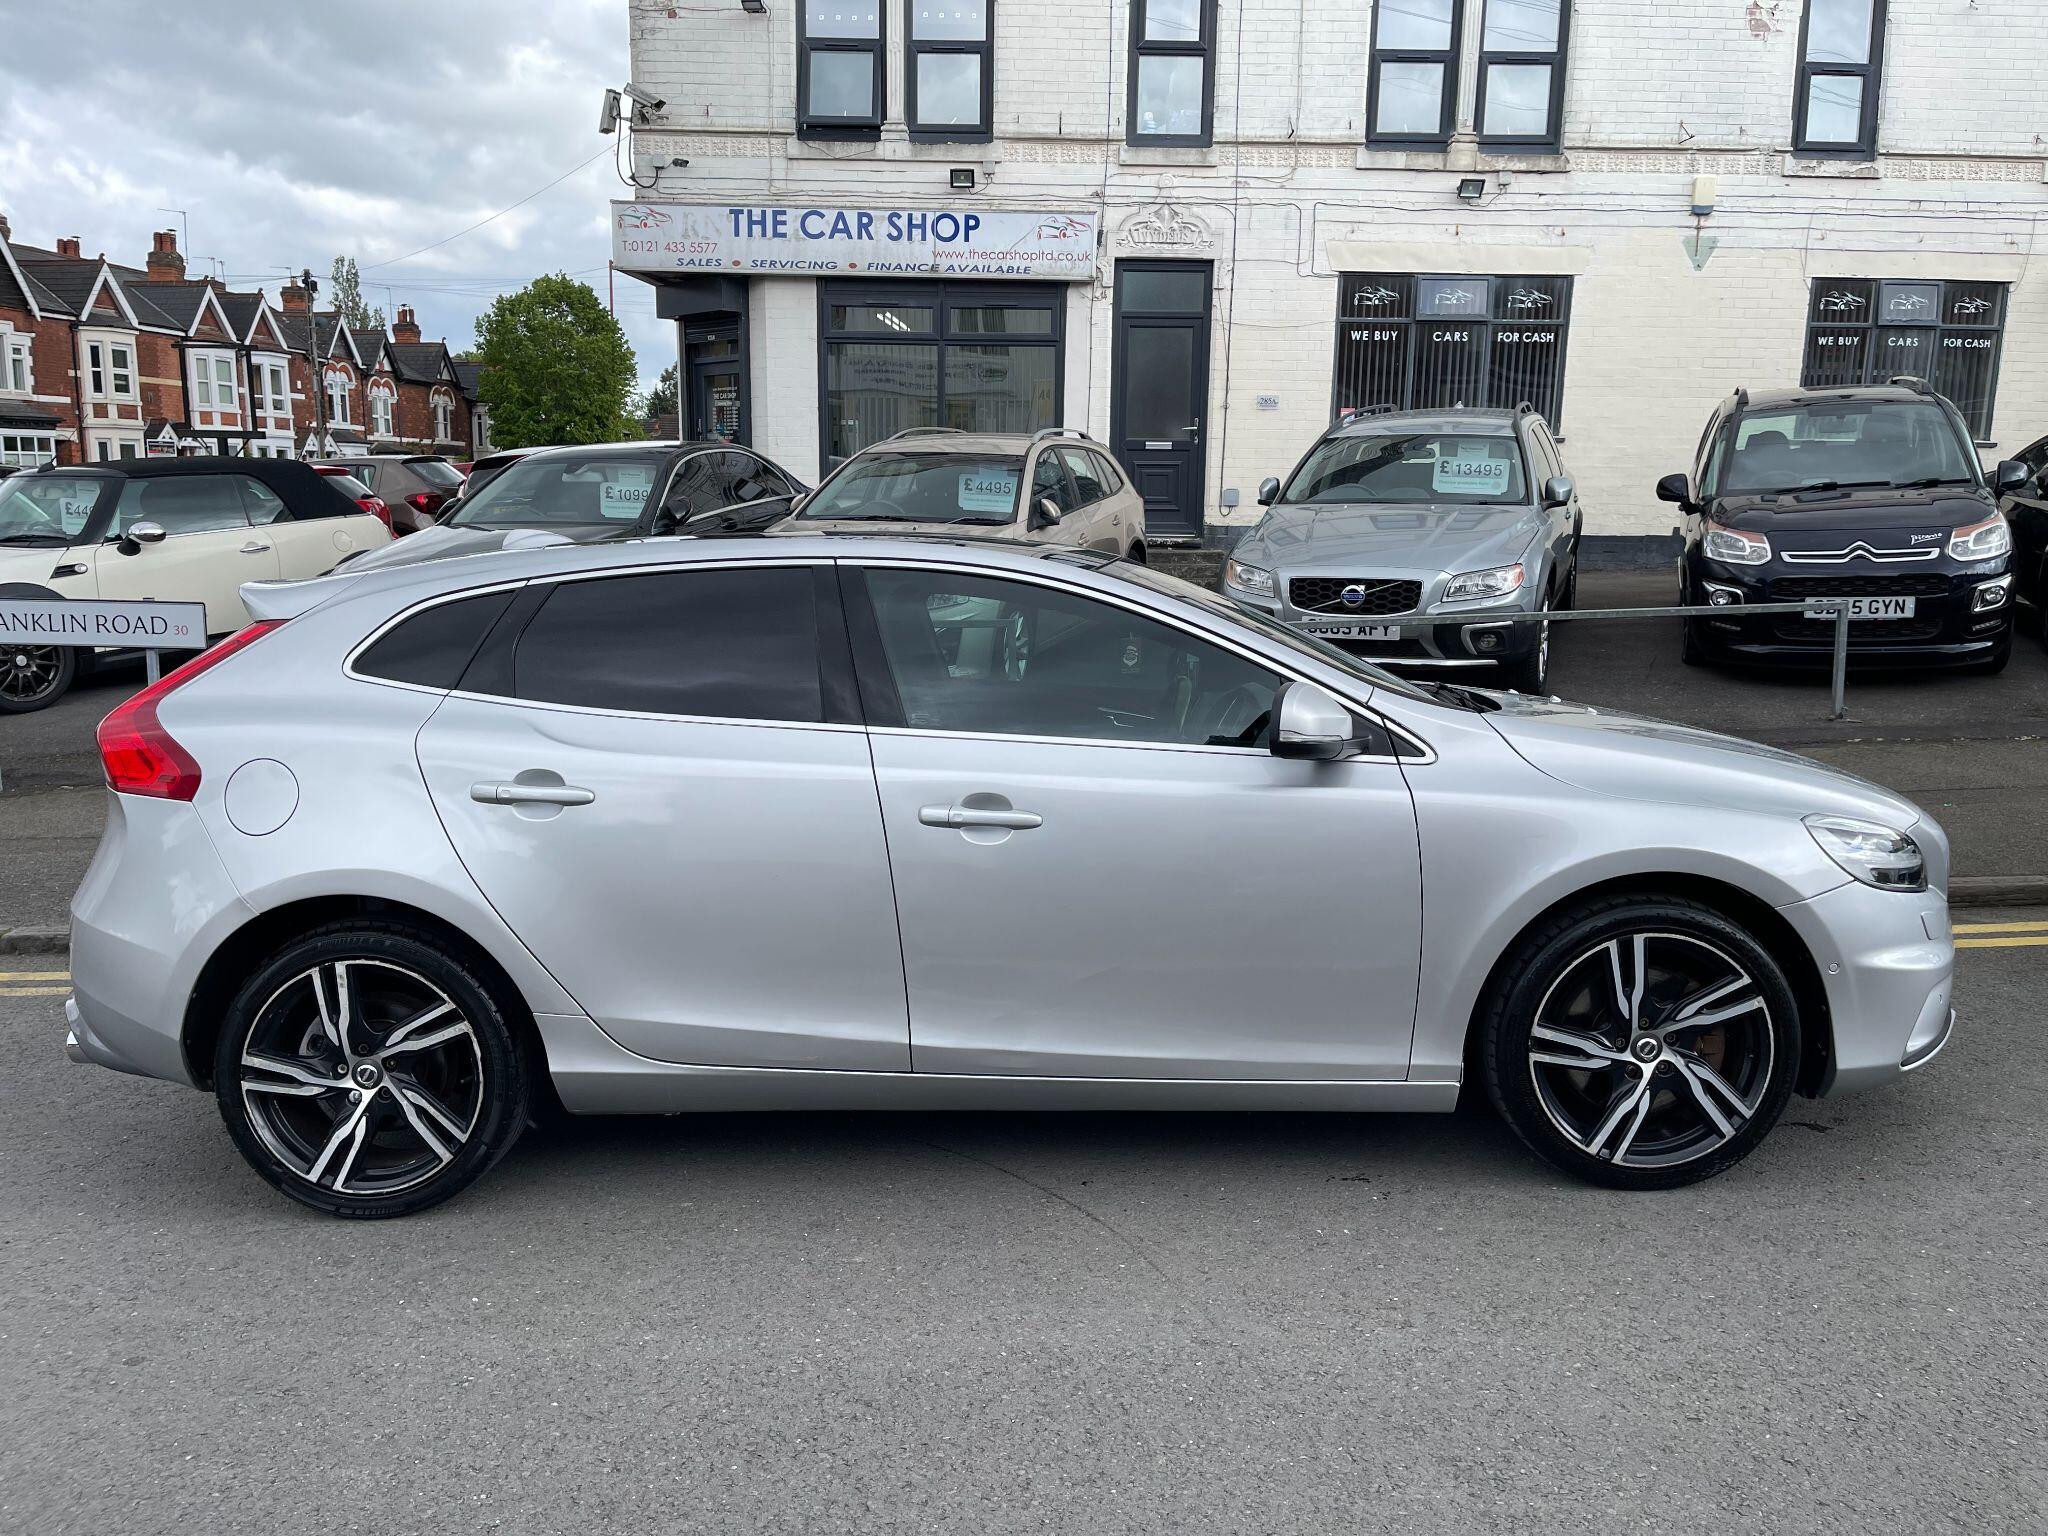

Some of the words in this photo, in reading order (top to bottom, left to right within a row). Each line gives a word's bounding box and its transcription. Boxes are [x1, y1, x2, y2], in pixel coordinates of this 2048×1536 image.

[729, 208, 788, 238] THE
[800, 209, 873, 240] CAR
[887, 211, 981, 242] SHOP
[622, 240, 659, 252] T:0121
[664, 241, 686, 253] 433
[689, 242, 718, 254] 5577
[932, 249, 1092, 264] www.thecarshopltd.co.uk
[676, 257, 722, 267] SALES
[750, 259, 838, 270] SERVICING
[866, 262, 940, 273] FINANCE
[944, 263, 1032, 275] AVAILABLE
[1350, 331, 1369, 341] WE
[1374, 331, 1399, 341] BUY
[1432, 331, 1469, 342] CARS
[1498, 332, 1519, 342] FOR
[1523, 332, 1554, 343] CASH
[1818, 337, 1834, 346] WE
[1838, 337, 1860, 346] BUY
[1888, 337, 1919, 347] CARS
[1943, 338, 1962, 348] FOR
[1965, 339, 1991, 348] CASH
[1869, 599, 1906, 614] GYN
[95, 614, 168, 635] ROAD
[173, 625, 189, 636] 30
